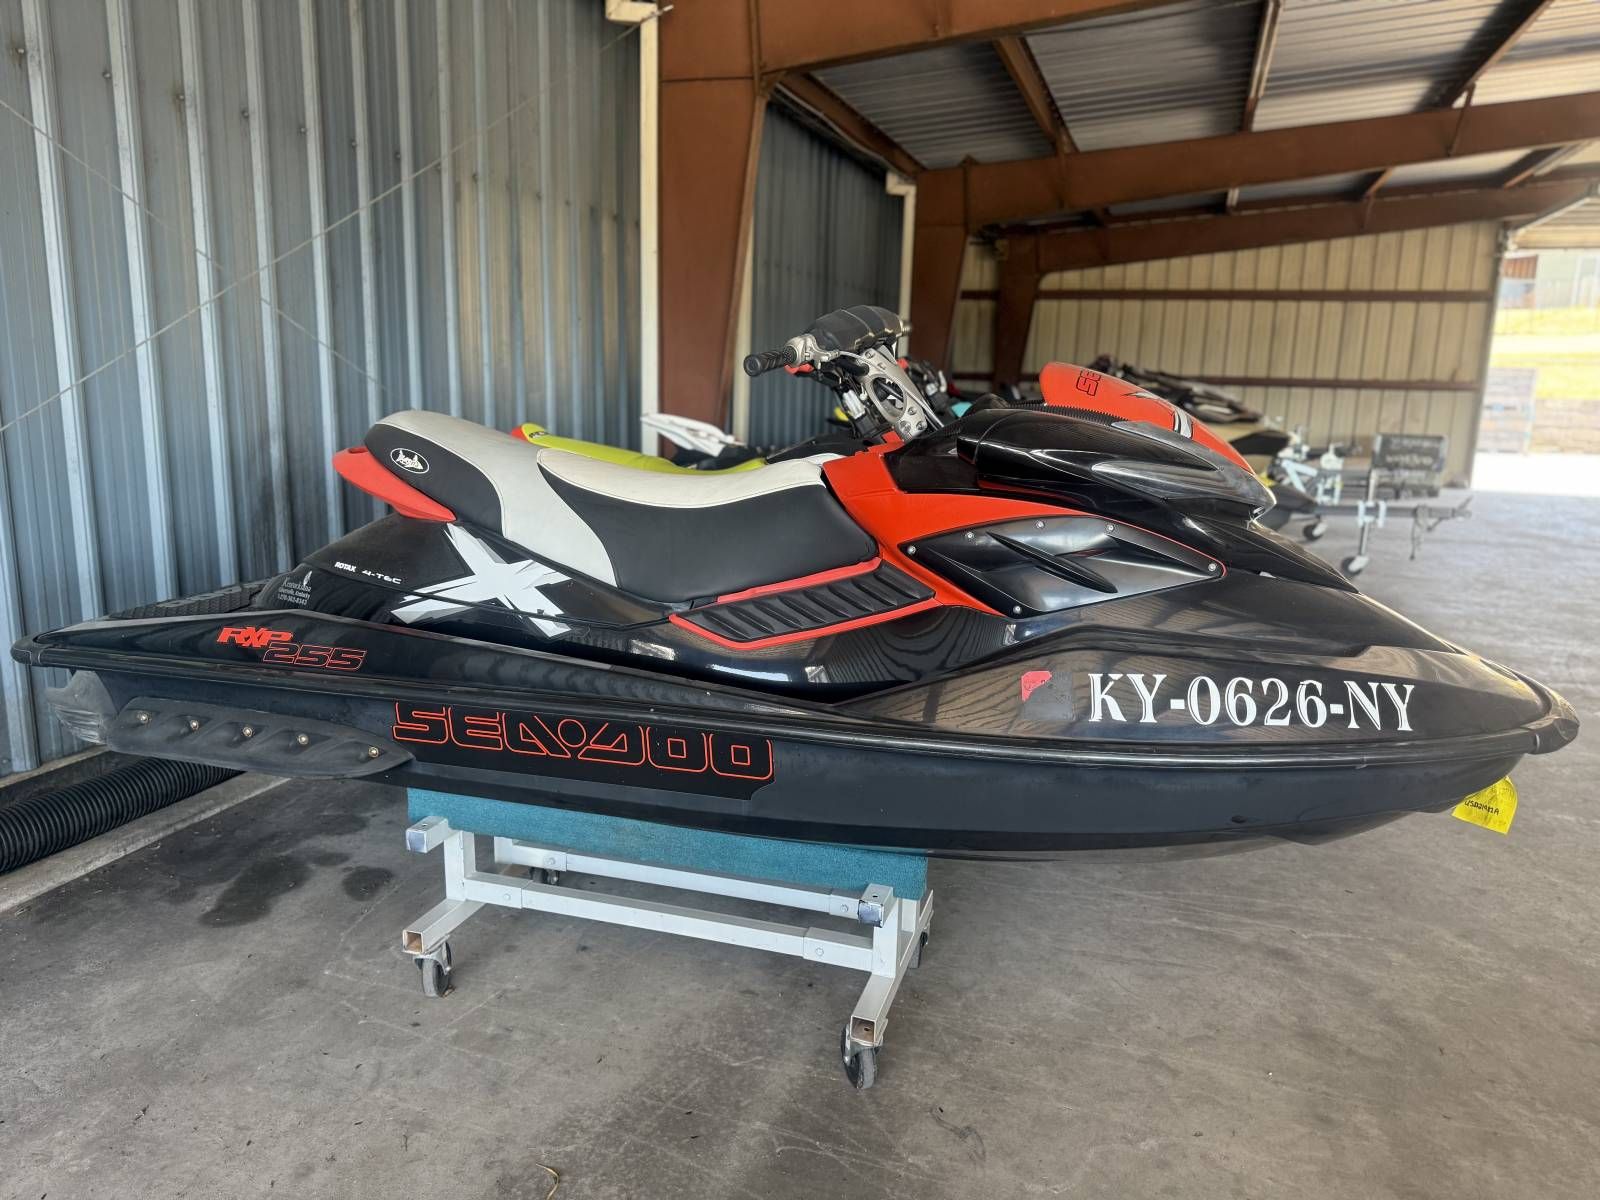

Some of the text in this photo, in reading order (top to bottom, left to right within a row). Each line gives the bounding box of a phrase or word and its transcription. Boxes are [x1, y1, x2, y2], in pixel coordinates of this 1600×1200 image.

[334, 561, 357, 573] ROTAX
[217, 626, 294, 649] RXP
[262, 642, 368, 671] 255
[1088, 673, 1415, 732] KY-0626-NY
